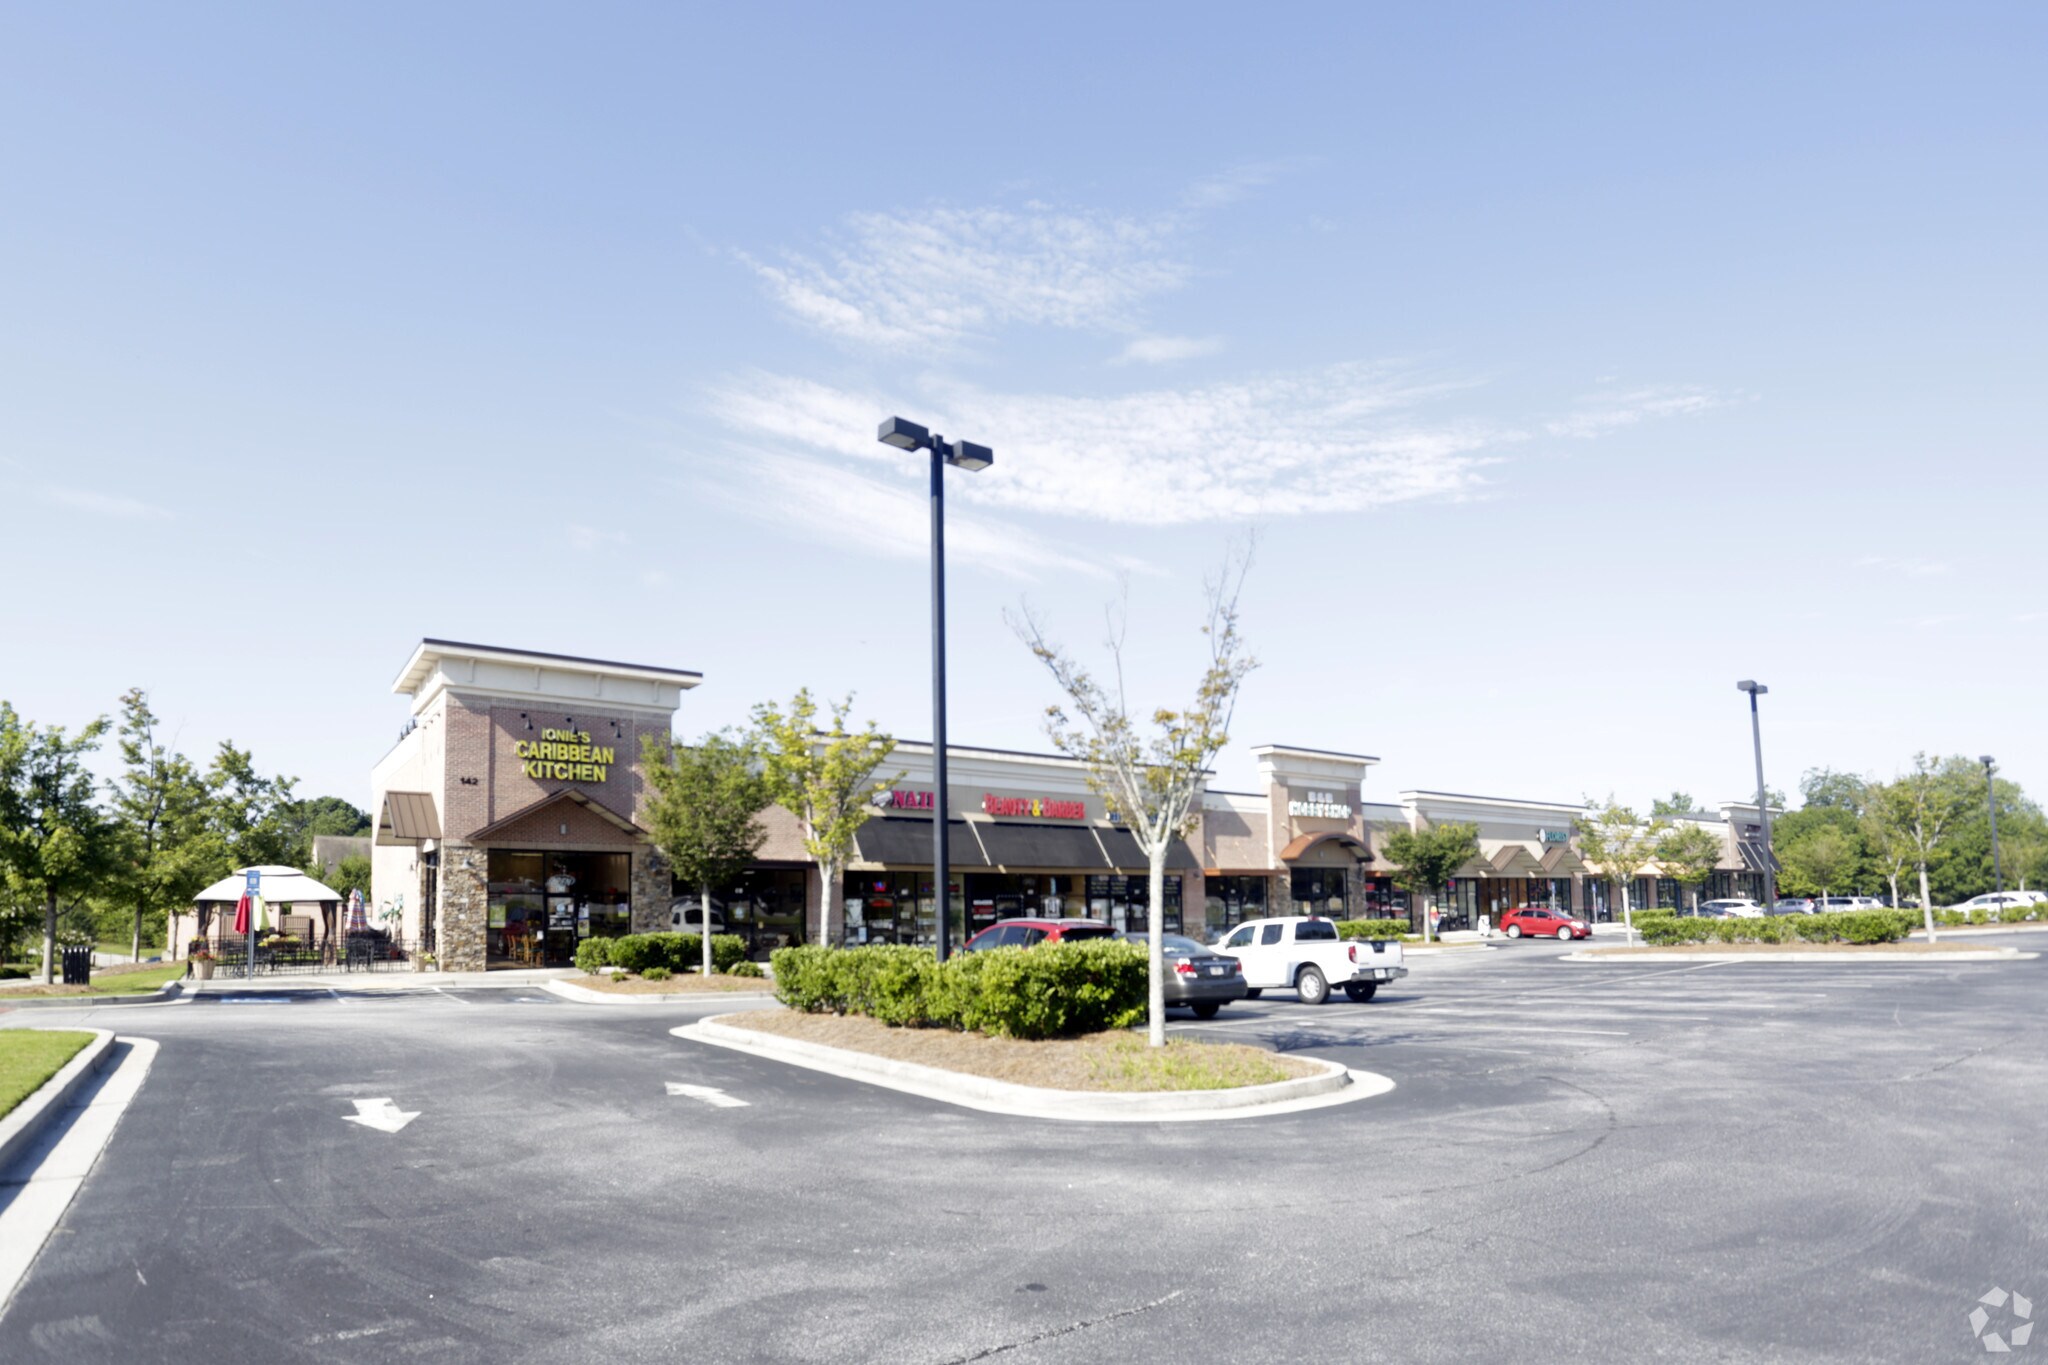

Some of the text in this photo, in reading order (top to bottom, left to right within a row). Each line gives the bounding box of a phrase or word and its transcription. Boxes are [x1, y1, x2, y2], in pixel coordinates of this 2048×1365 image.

[514, 740, 615, 765] CARIBBEAN
[460, 776, 479, 786] 142
[522, 760, 607, 782] KITCHEN
[1032, 799, 1041, 817] &
